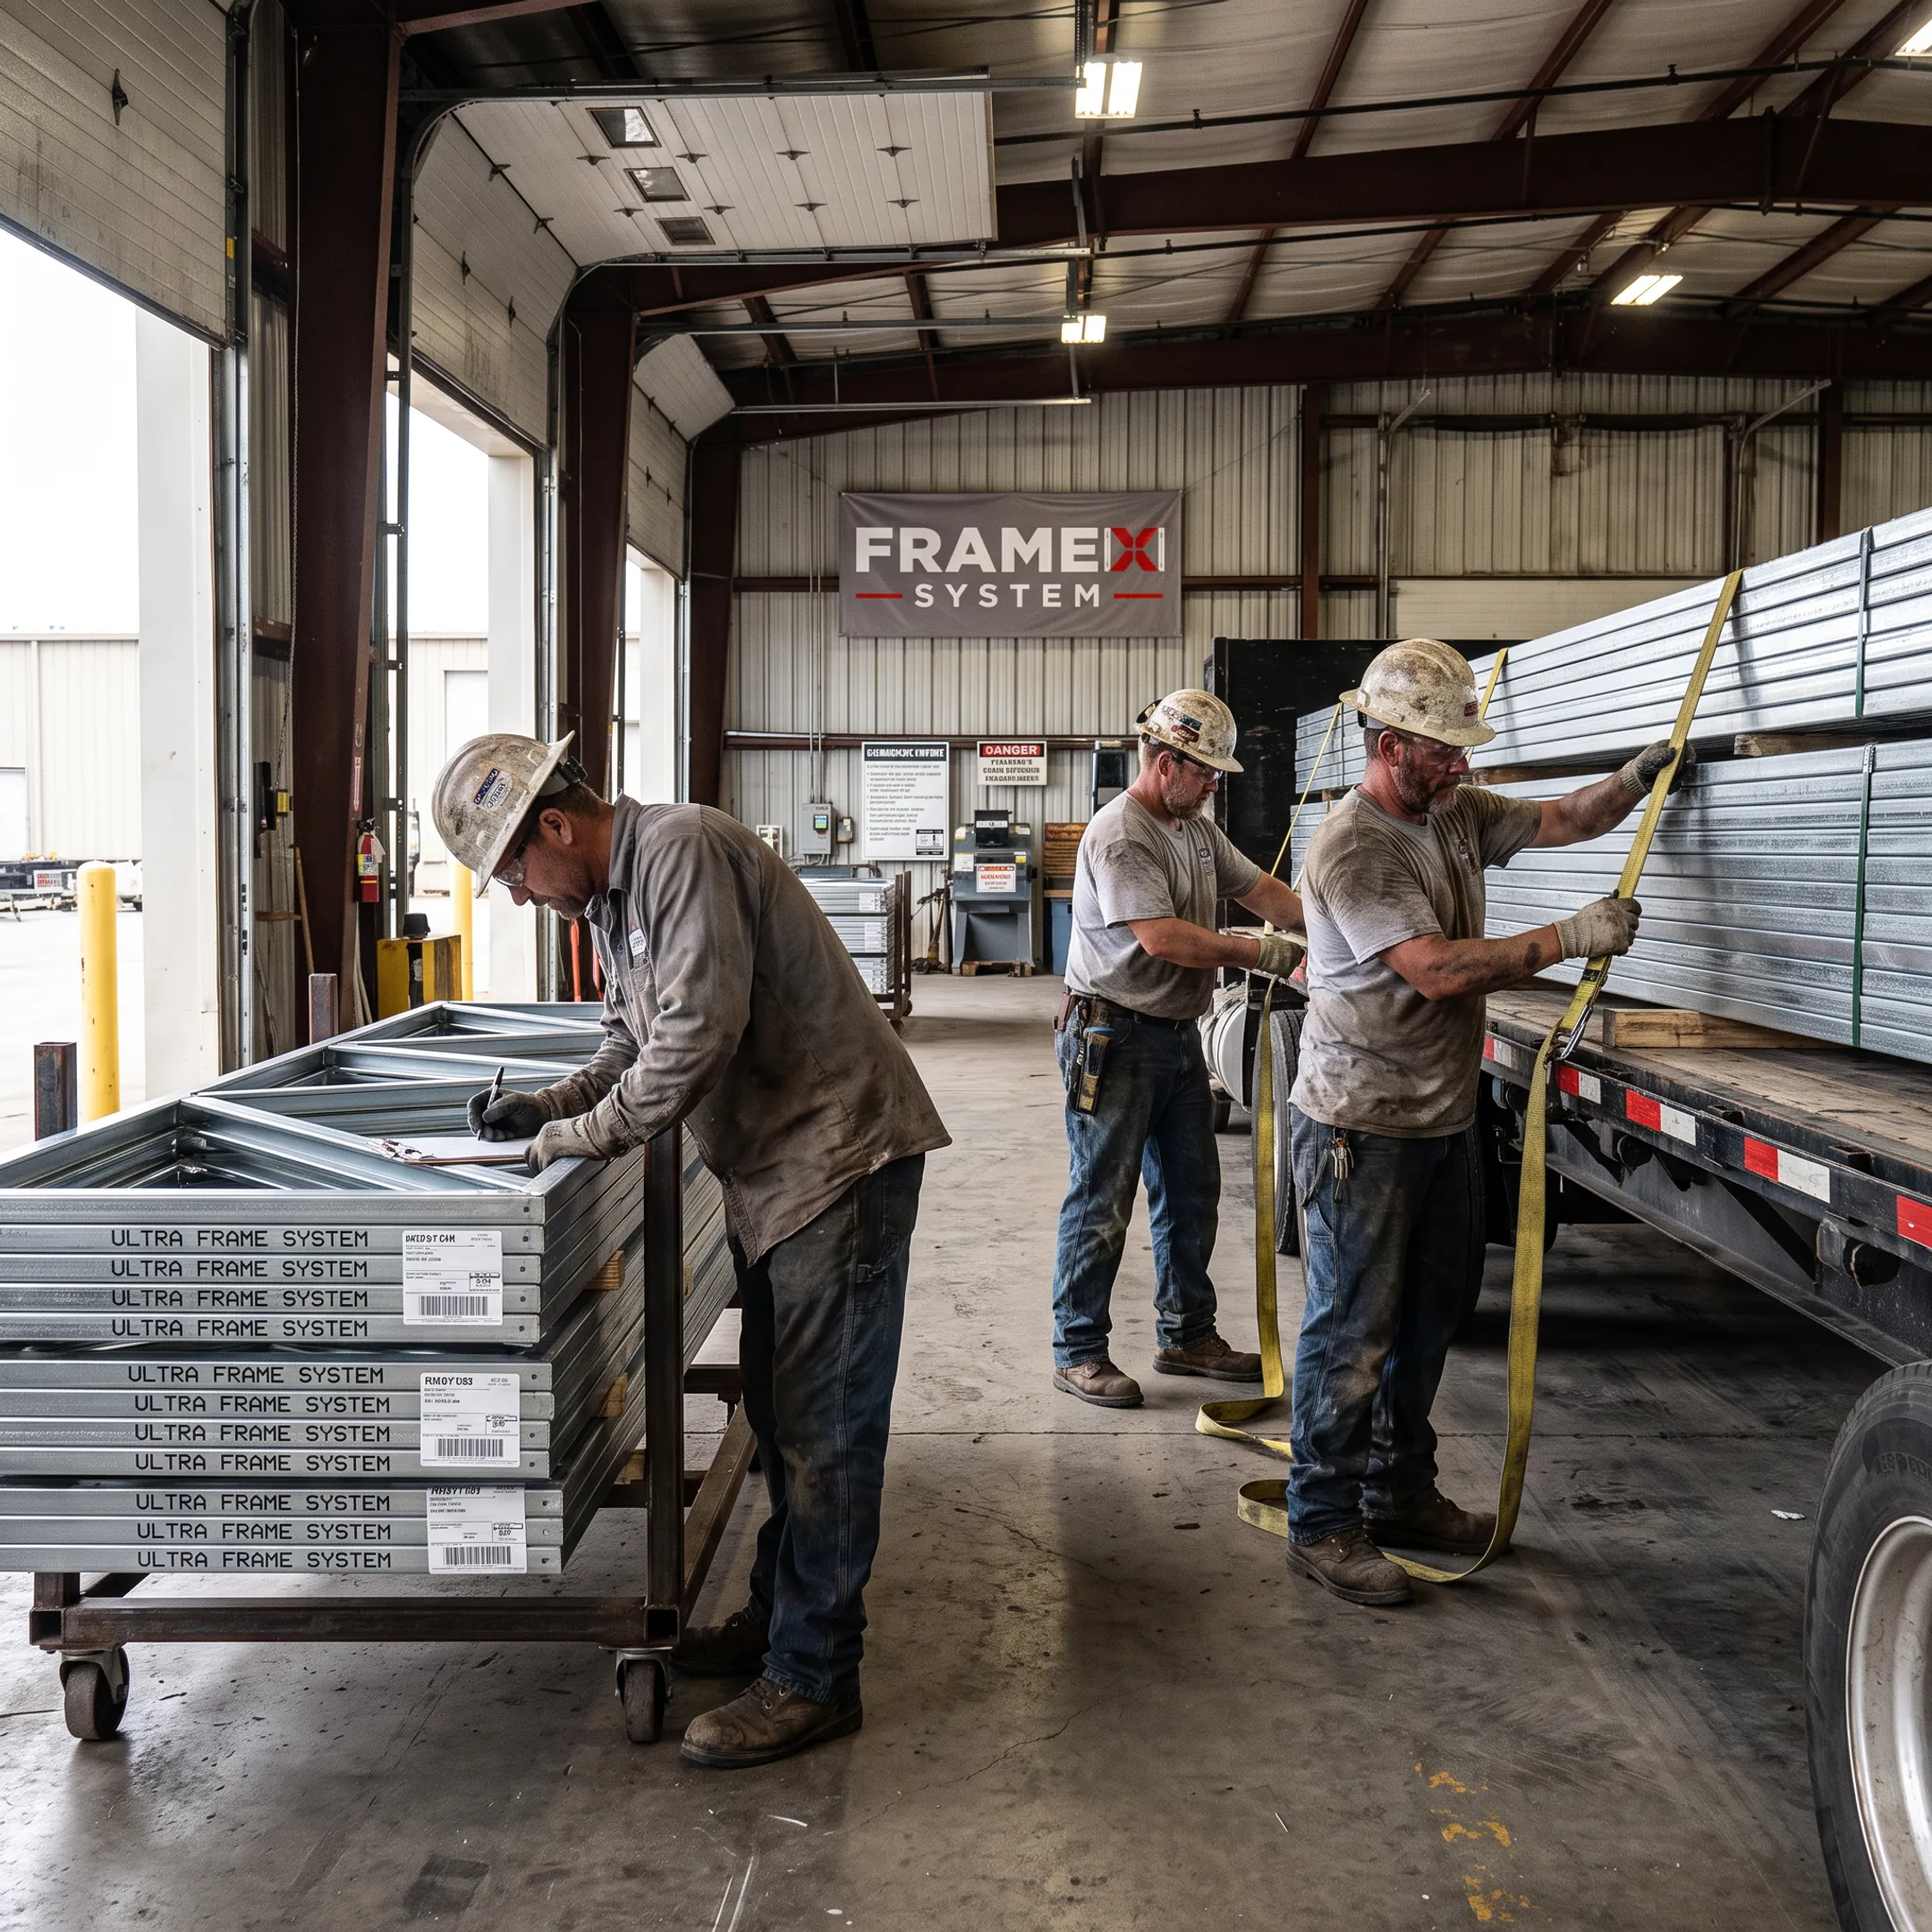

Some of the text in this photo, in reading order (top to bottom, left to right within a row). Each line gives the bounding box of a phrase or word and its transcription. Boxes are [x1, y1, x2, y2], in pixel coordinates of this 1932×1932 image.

[855, 527, 1165, 572] FRAMEX
[914, 583, 1100, 607] SYSTEM
[985, 745, 1038, 755] DANGER
[112, 1229, 368, 1248] ULTRA FRAME SYSTEM
[112, 1259, 368, 1278] ULTRA FRAME SYSTEM
[112, 1289, 368, 1308] ULTRA FRAME SYSTEM
[112, 1318, 368, 1337] ULTRA FRAME SYSTEM
[129, 1365, 384, 1384] ULTRA FRAME SYSTEM
[135, 1394, 390, 1413] ULTRA FRAME SYSTEM
[135, 1424, 390, 1443] ULTRA FRAME SYSTEM
[136, 1453, 390, 1472] ULTRA FRAME SYSTEM
[137, 1493, 390, 1512] ULTRA FRAME SYSTEM
[138, 1522, 391, 1540] ULTRA FRAME SYSTEM
[139, 1551, 391, 1568] ULTRA FRAME SYSTEM
